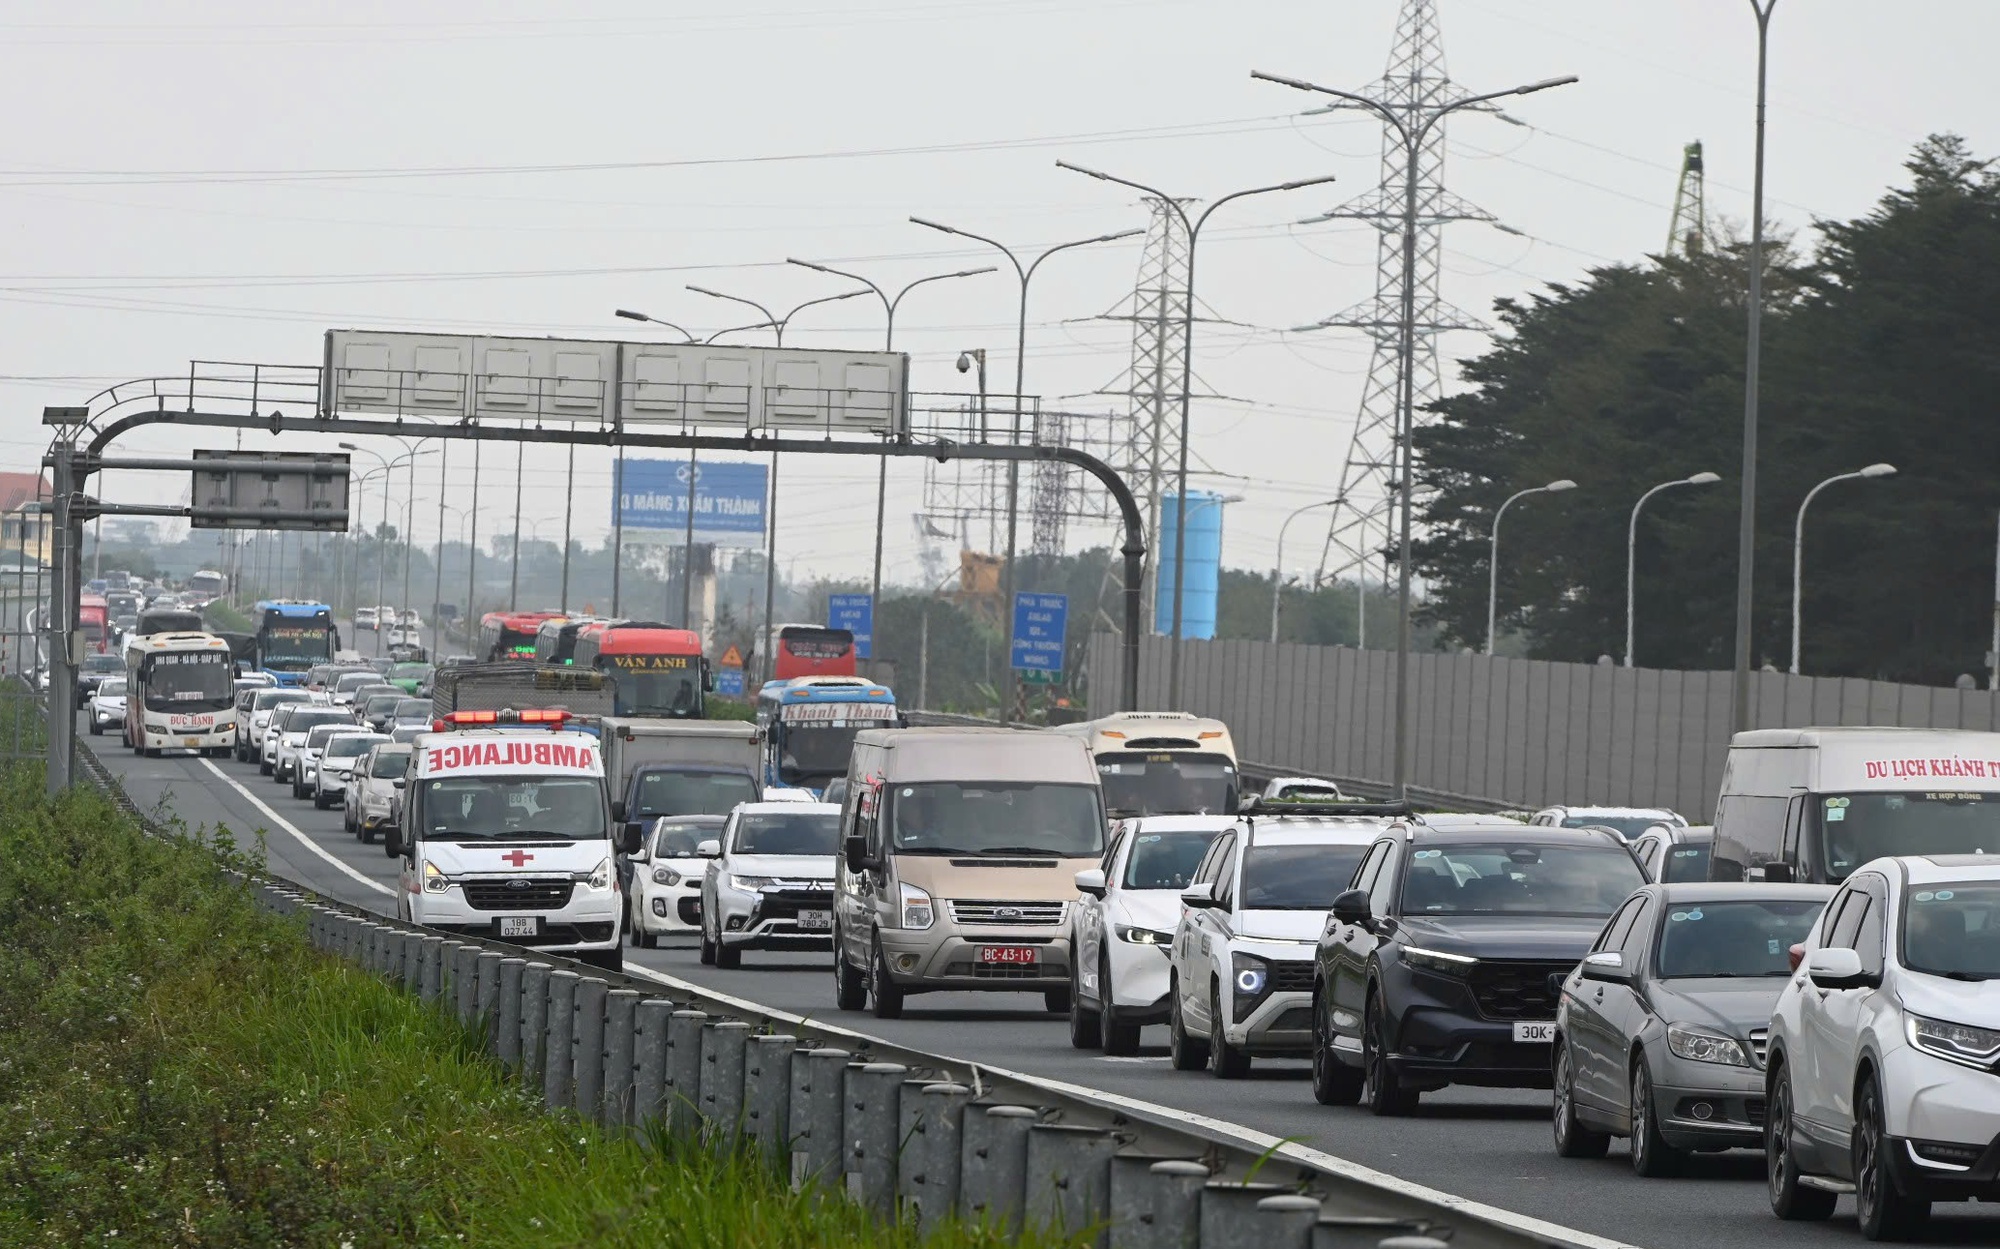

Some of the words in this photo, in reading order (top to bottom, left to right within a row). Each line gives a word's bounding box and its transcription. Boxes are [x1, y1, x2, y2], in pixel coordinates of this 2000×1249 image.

[652, 657, 687, 668] ANH
[1866, 761, 1888, 778] DU
[1892, 760, 1927, 780] LỊCH
[1930, 755, 1986, 777] KHÁNH
[1988, 762, 2000, 777] T
[808, 911, 822, 919] 30H
[504, 927, 533, 936] 027.44
[984, 948, 1032, 961] BC-43-19
[1522, 1026, 1556, 1039] 30K-
